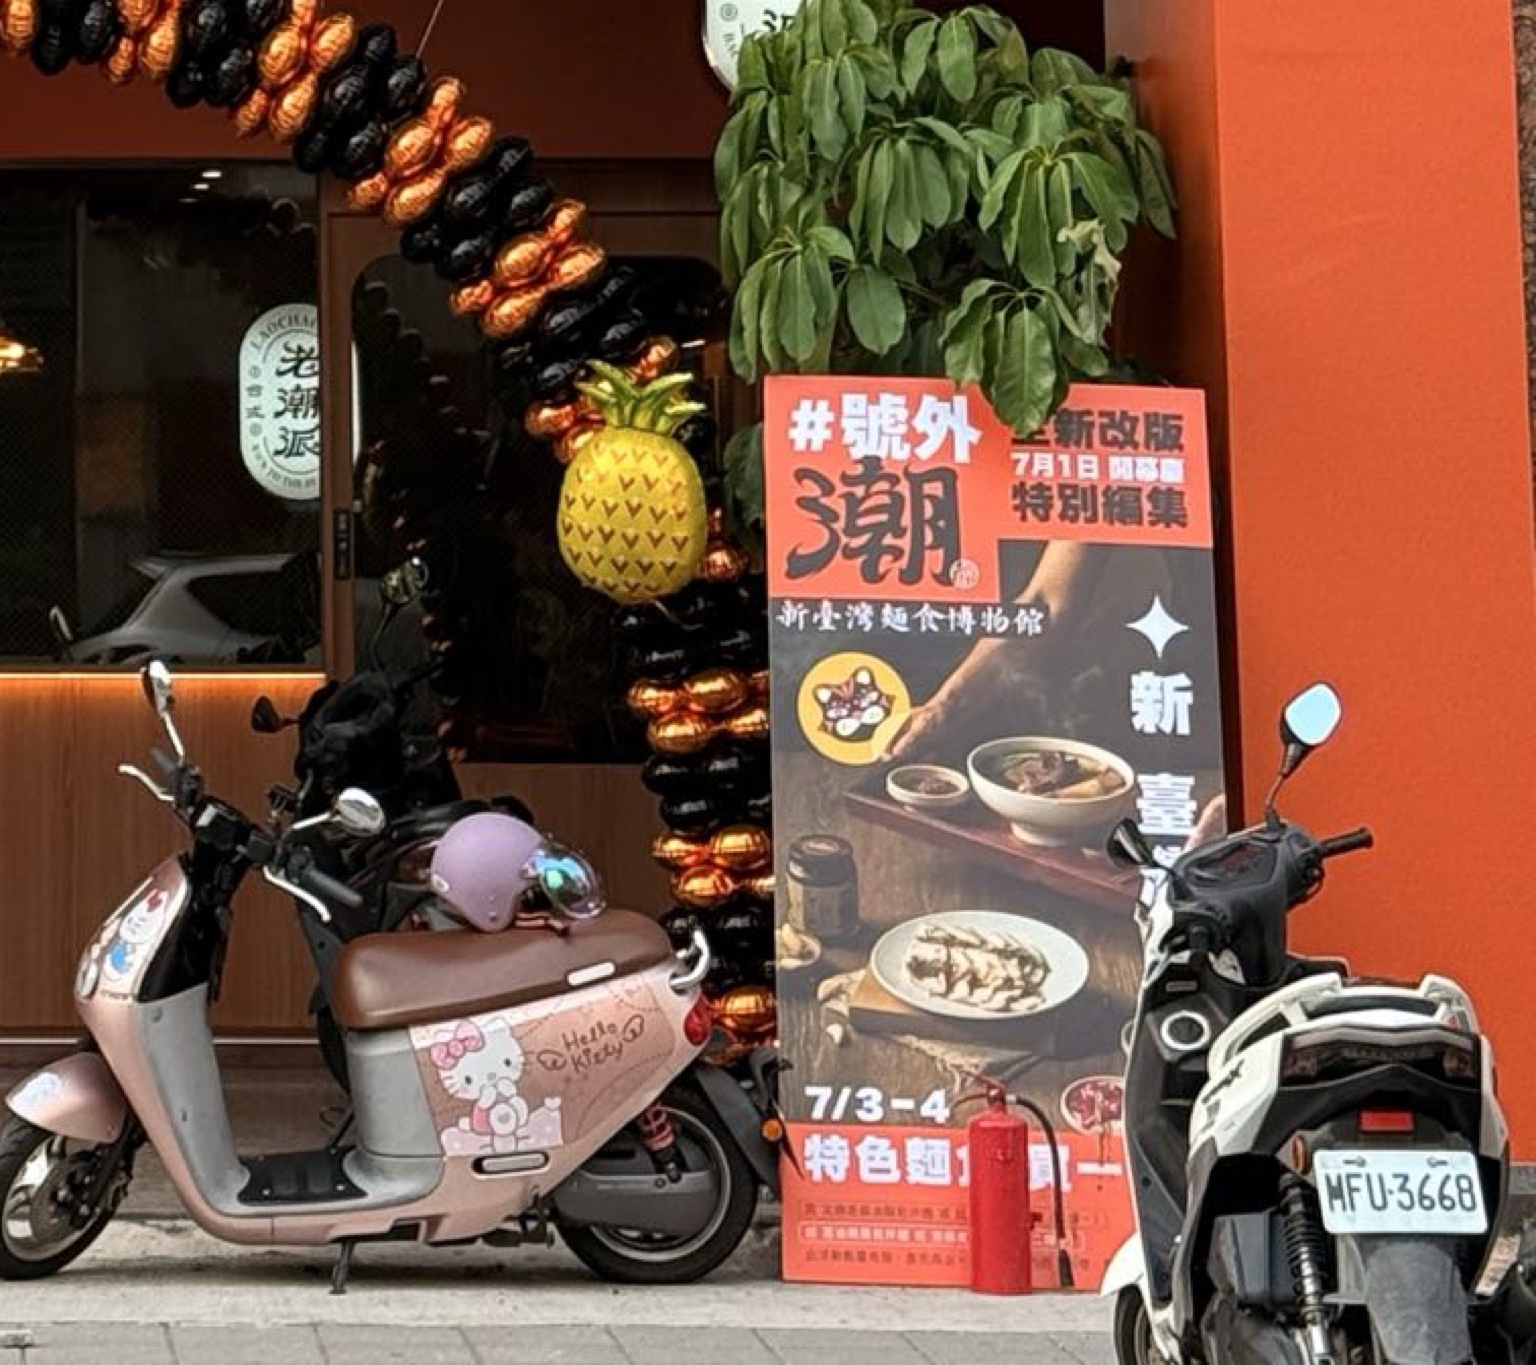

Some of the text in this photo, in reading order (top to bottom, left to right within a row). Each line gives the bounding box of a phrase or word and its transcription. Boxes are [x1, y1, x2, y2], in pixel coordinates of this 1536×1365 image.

[788, 391, 982, 464] #號外
[1010, 452, 1099, 480] 7月1日
[785, 455, 962, 586] 潮
[1011, 481, 1187, 529] 特別編集
[561, 1019, 618, 1052] Hello
[804, 1086, 950, 1124] 7/3-4
[804, 1132, 969, 1187] 特色麵
